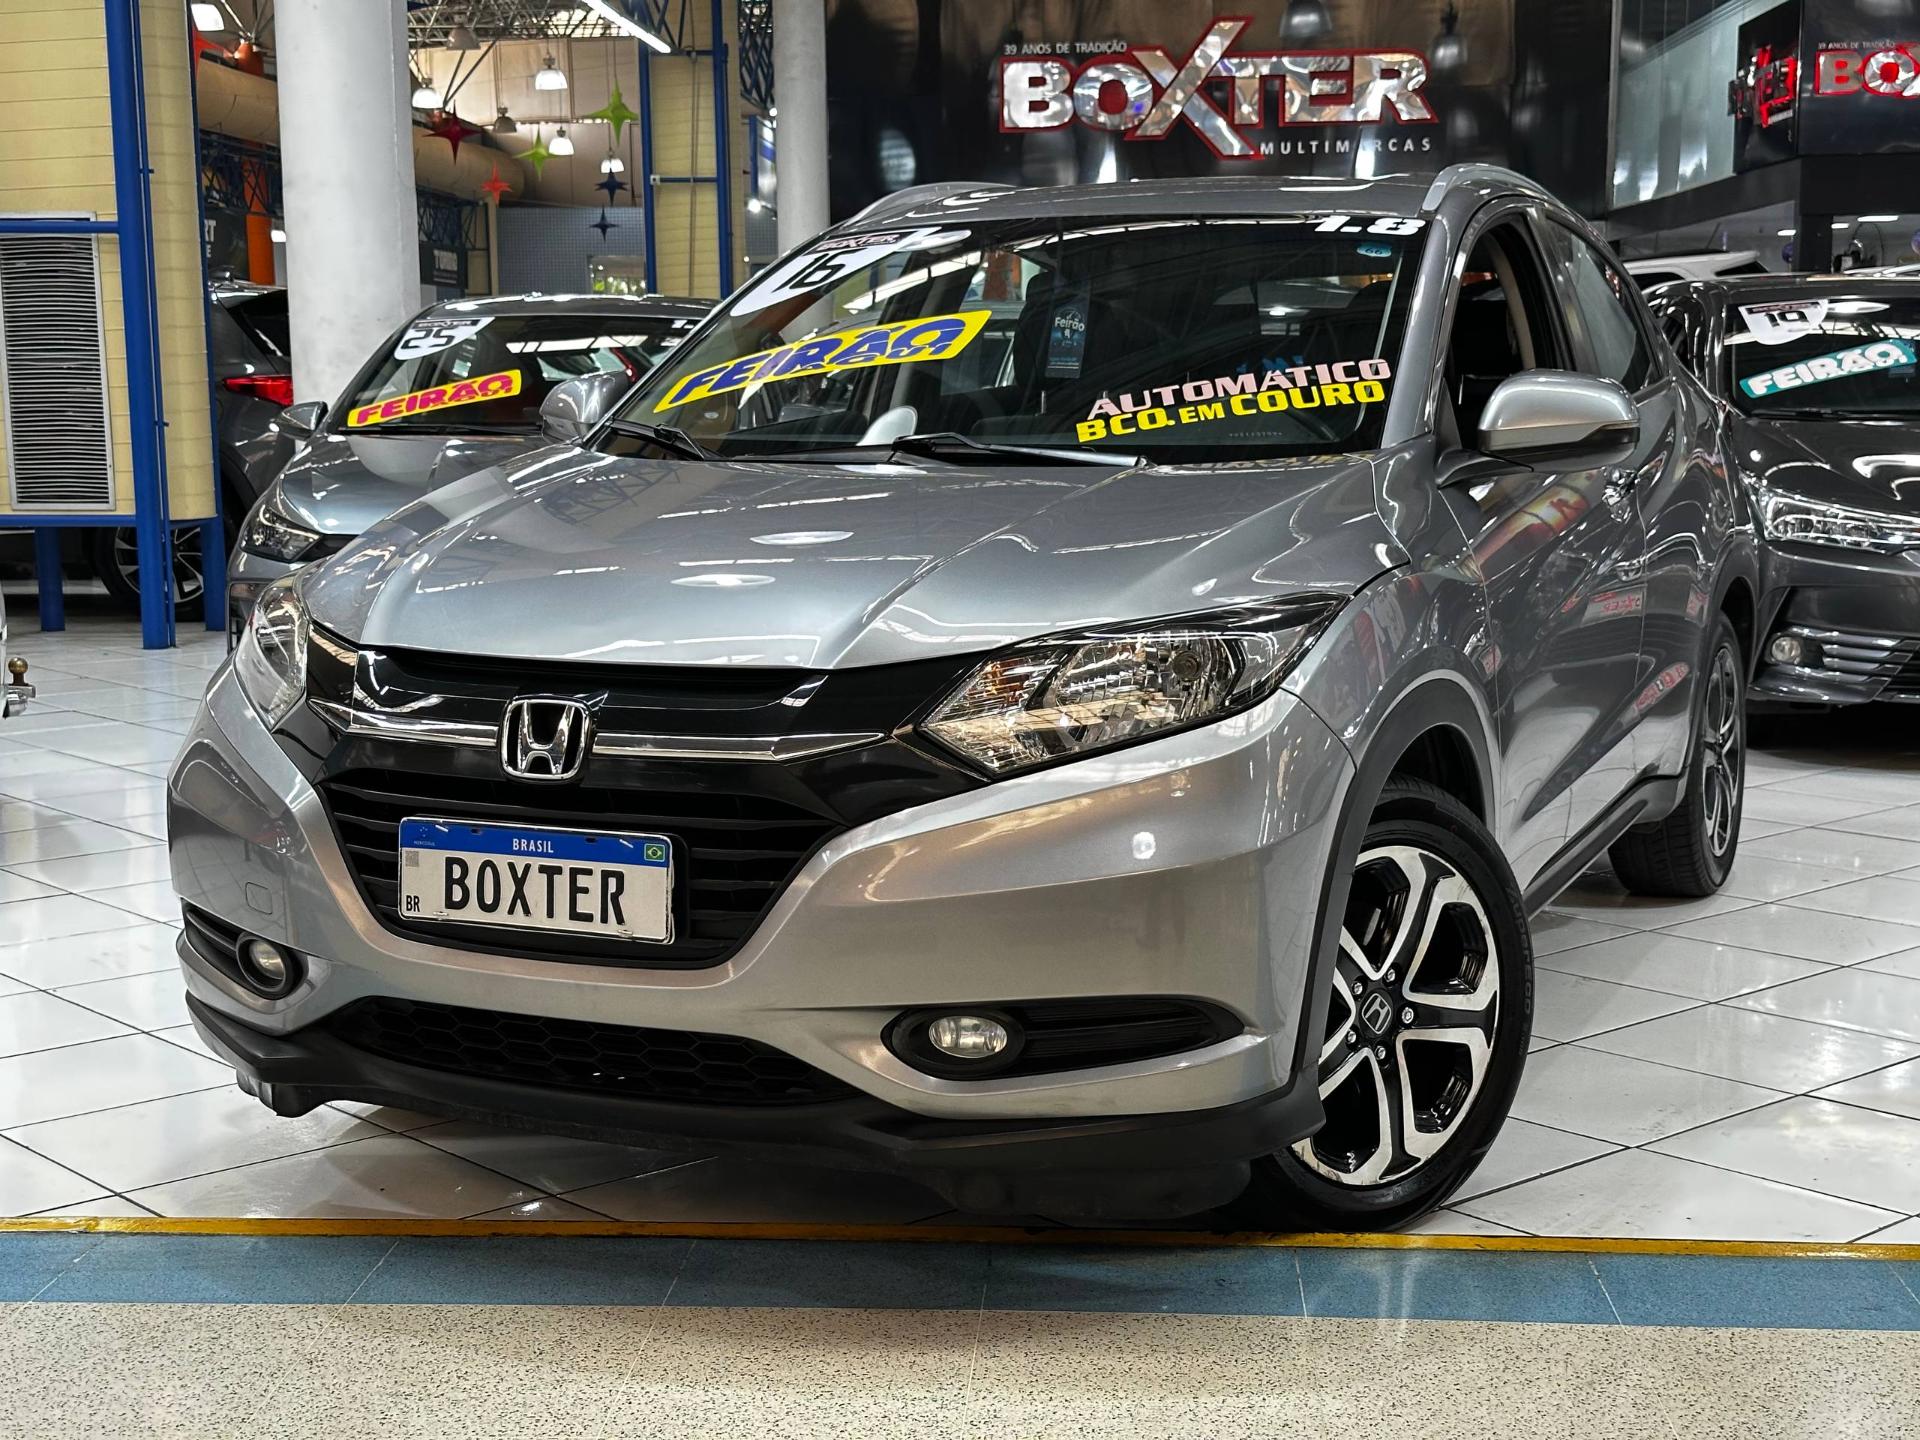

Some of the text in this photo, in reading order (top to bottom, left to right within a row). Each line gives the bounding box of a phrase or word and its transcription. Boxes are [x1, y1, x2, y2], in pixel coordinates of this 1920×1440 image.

[1003, 40, 1128, 55] 39 ANOS DE TRADIÇÃO
[1002, 19, 1433, 157] BOXTER
[1314, 215, 1427, 236] 1.8
[771, 247, 867, 293] 16
[400, 326, 459, 350] 25
[1054, 317, 1086, 332] Feirão
[1748, 343, 1908, 395] FEIRÃO
[356, 374, 513, 424] FEIRÃO
[1075, 380, 1386, 443] BCO. EM COURO
[512, 838, 554, 854] BRASIL
[405, 894, 421, 913] BR
[444, 856, 626, 926] BOXTER
